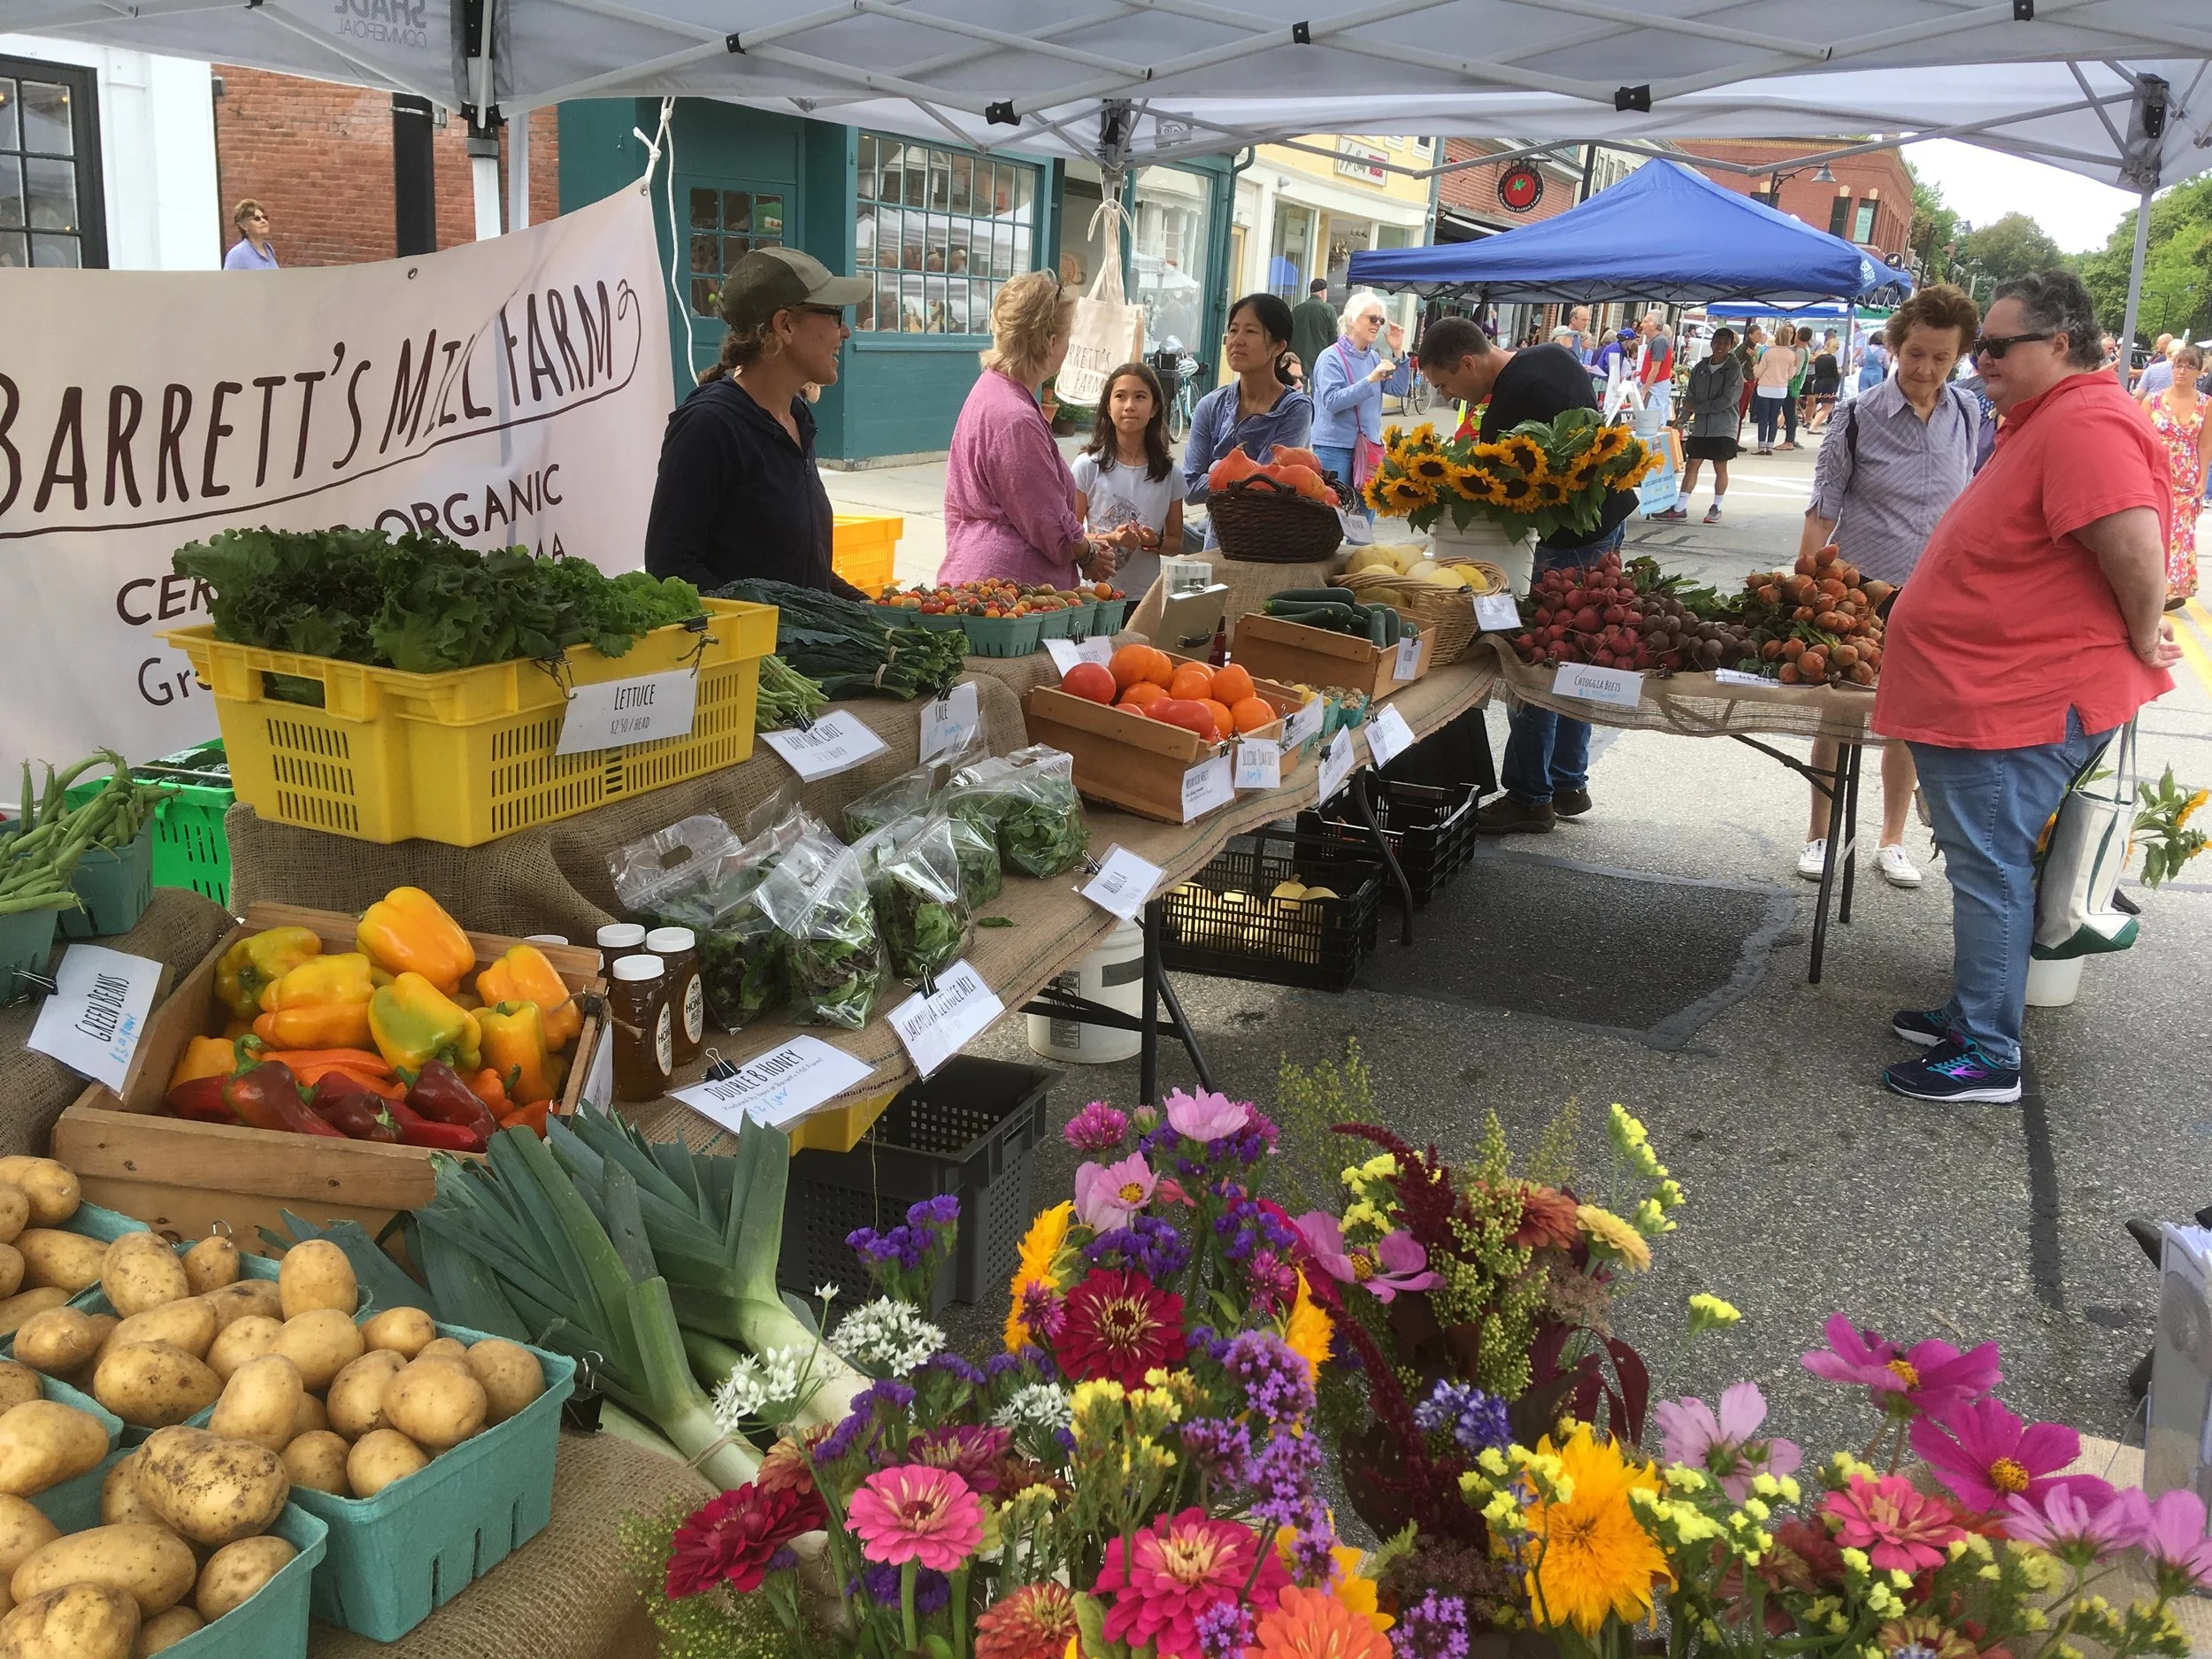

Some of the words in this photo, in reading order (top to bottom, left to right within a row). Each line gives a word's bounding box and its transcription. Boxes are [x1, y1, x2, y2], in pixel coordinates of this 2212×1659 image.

[1067, 343, 1111, 373] RRETT'S
[0, 342, 373, 517] BARRETT'S
[498, 280, 613, 407] FARM
[373, 463, 564, 543] ORGANIC
[614, 683, 657, 710] LETTUCE
[1574, 675, 1603, 690] CHIOGGIA
[1604, 680, 1622, 692] BEETS
[634, 716, 650, 731] HEAD
[814, 723, 844, 741] CHOI
[87, 972, 130, 1009] BEANS
[75, 1001, 120, 1042] GREEN
[902, 1003, 940, 1041] SALANOVA
[929, 985, 964, 1017] LETTUCE
[956, 975, 977, 996] MIX
[746, 1069, 768, 1082] B
[755, 1048, 804, 1077] HONEY
[703, 1075, 761, 1102] DOUBLE
